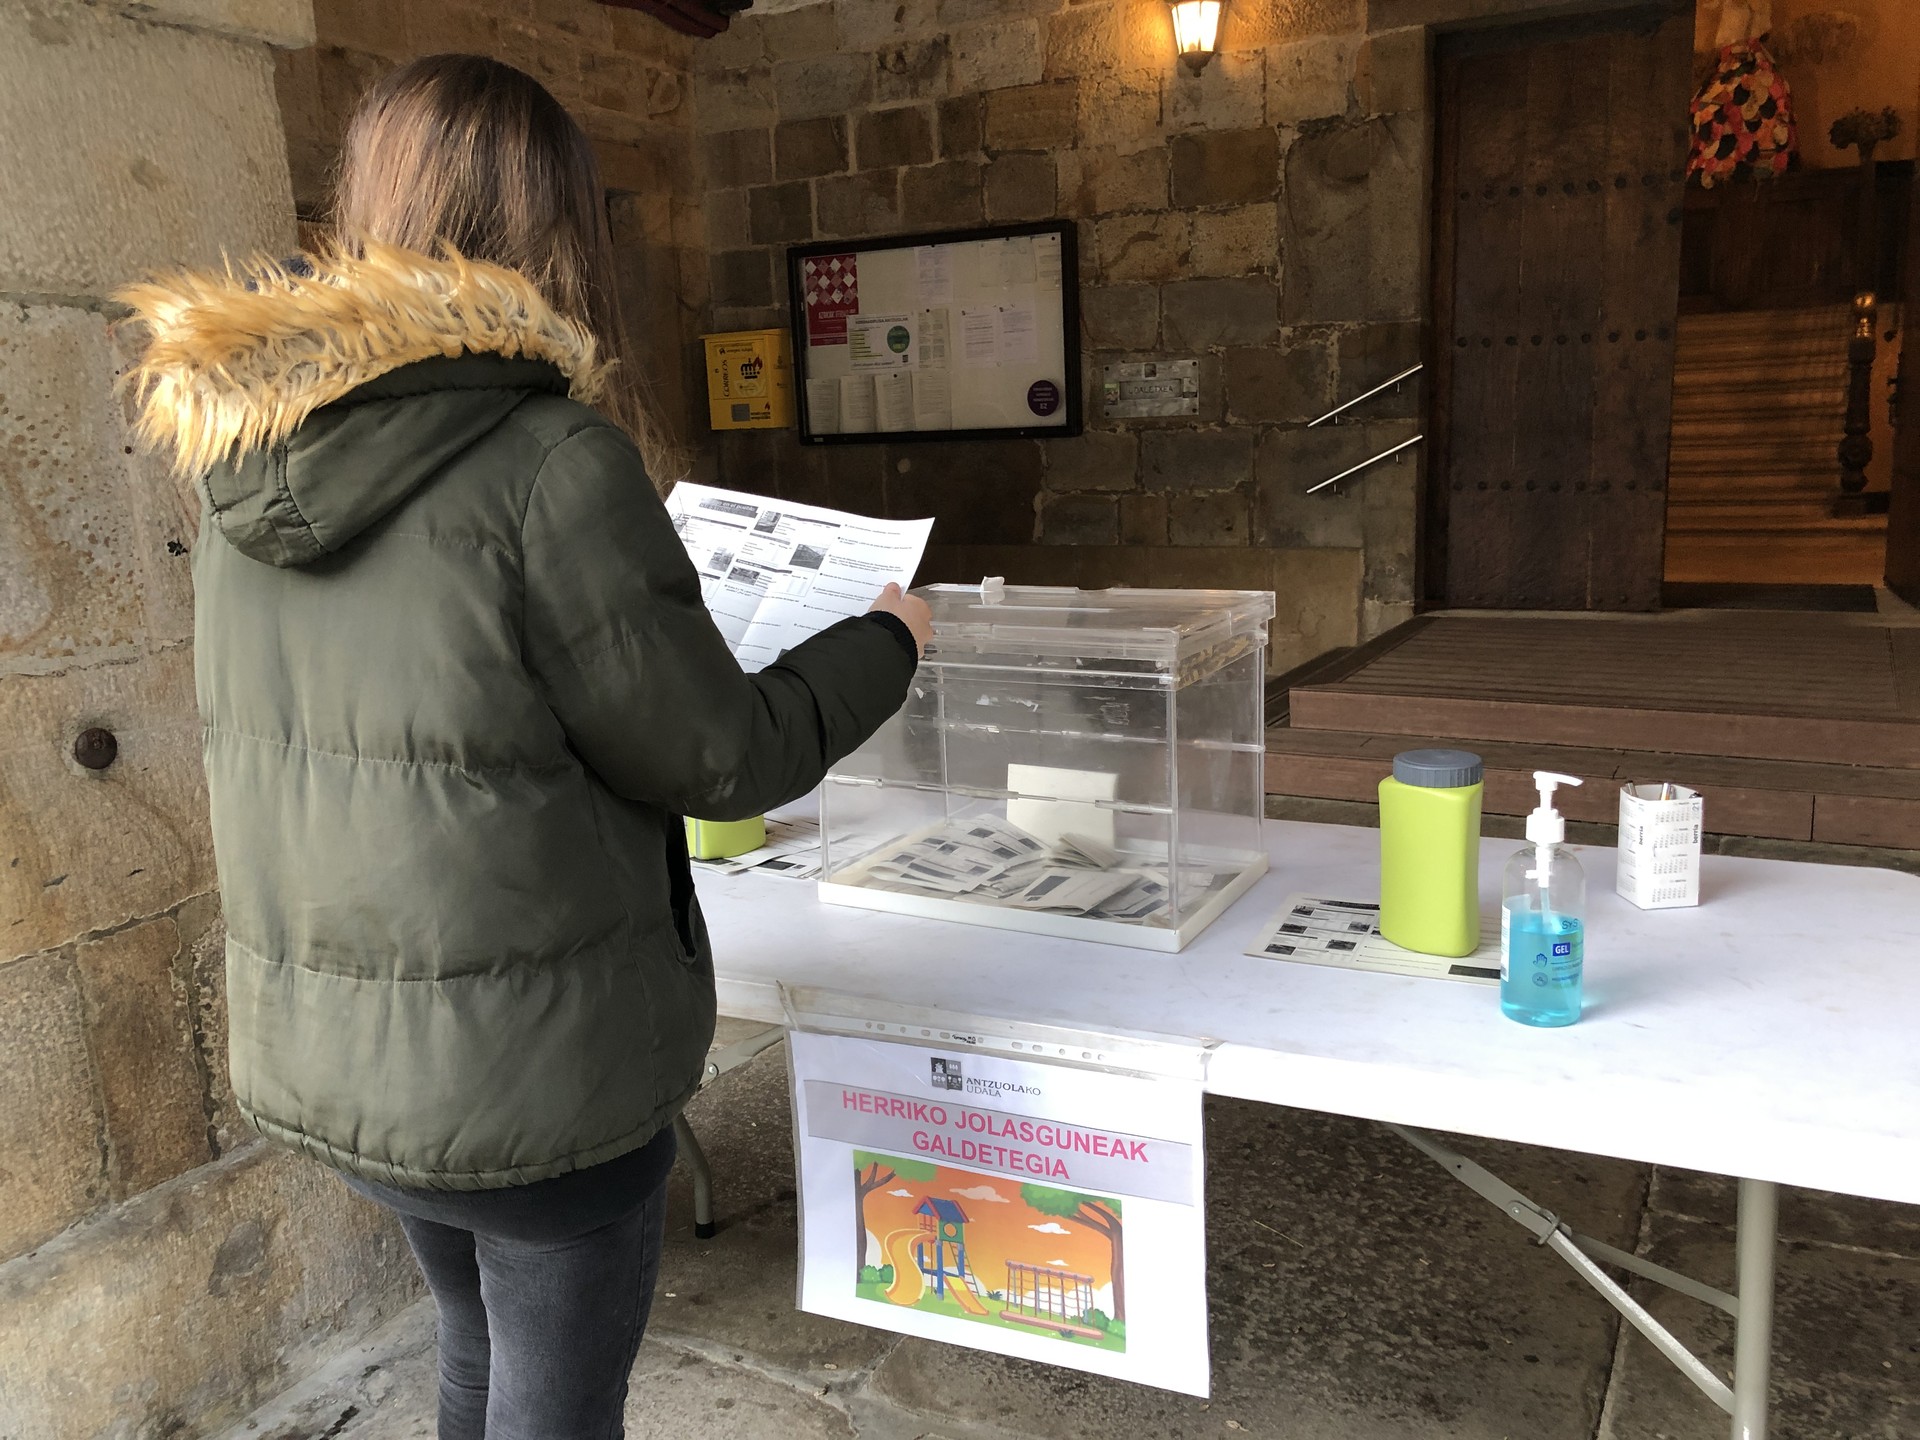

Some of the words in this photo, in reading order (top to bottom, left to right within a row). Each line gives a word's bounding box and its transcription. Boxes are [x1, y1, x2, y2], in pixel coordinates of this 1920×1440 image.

[721, 359, 730, 397] CORREOS
[1555, 945, 1569, 954] GEL
[965, 1077, 1042, 1097] ANTZUOLAKO
[966, 1085, 1002, 1098] UDALA
[842, 1090, 947, 1127] HERRIKO
[912, 1130, 1070, 1180] GALDETEGIA
[954, 1110, 1149, 1163] JOLASGUNEAK
